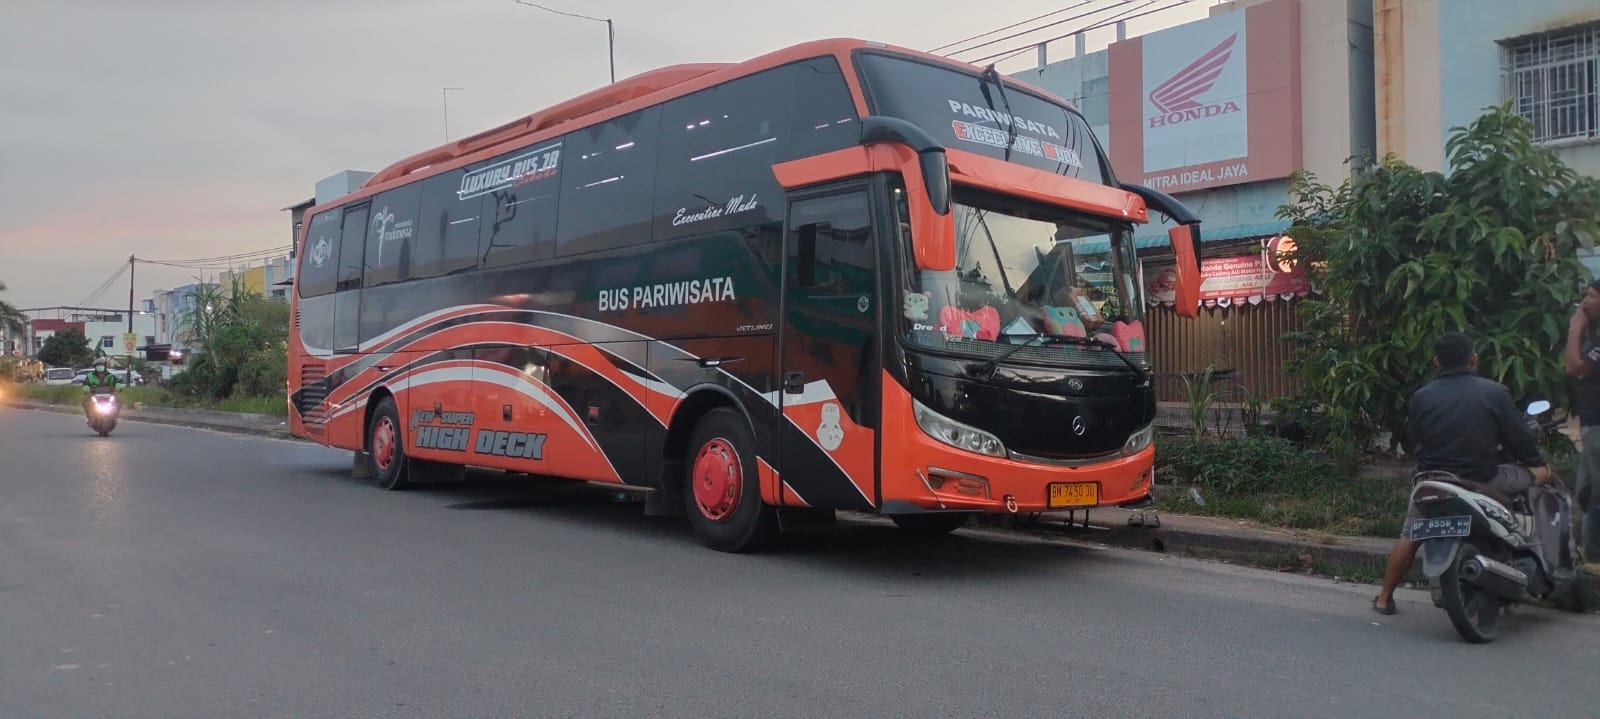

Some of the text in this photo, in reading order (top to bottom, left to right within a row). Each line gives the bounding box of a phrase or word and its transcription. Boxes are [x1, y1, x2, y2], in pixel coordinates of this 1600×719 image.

[948, 99, 1060, 139] PARIWISATA
[1149, 101, 1241, 128] HONDA
[463, 170, 511, 195] LUXURY
[512, 156, 539, 181] BUS
[1143, 163, 1248, 189] MITRA IDEAL JAYA
[724, 193, 758, 215] Muda
[1201, 263, 1222, 272] Honda
[1223, 262, 1253, 270] Genuine
[598, 276, 735, 312] BUS PARIWISATA
[441, 411, 475, 425] SUPER
[415, 425, 547, 460] HIGH DECK
[1052, 485, 1062, 498] BM
[1065, 485, 1083, 498] 7450
